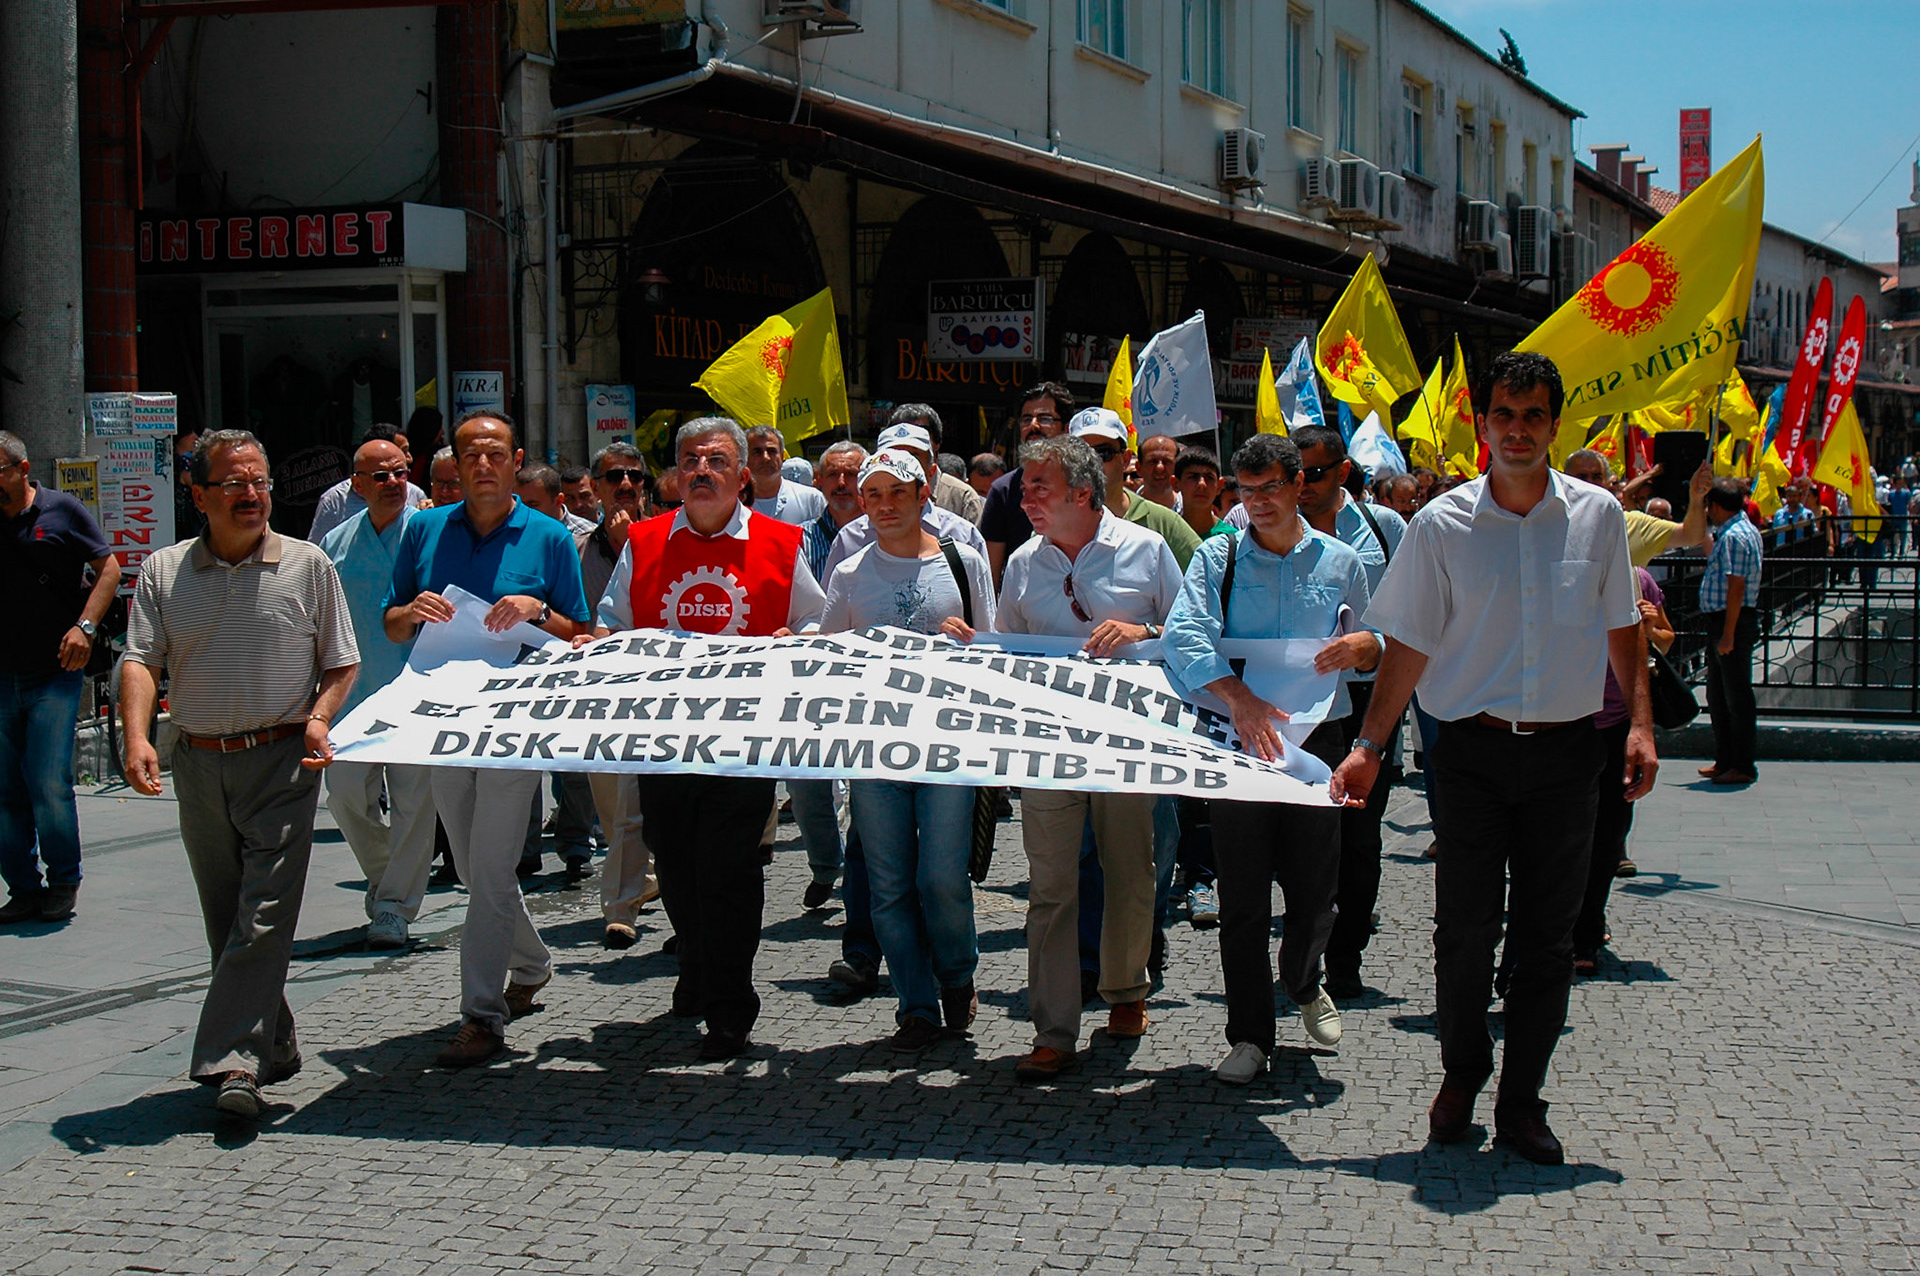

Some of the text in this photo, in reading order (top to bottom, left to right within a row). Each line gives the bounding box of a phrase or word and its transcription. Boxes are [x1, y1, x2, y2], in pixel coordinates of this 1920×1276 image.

[139, 210, 392, 263] İNTERNET
[933, 293, 1032, 311] BARUTÇU
[653, 306, 722, 360] KİTAP
[962, 315, 1018, 323] SAYISAL
[952, 325, 1020, 354] LOTO
[1023, 316, 1033, 354] 6/49
[457, 379, 499, 393] IKRA
[678, 593, 731, 617] DİSK
[790, 660, 867, 679] VE
[488, 691, 761, 722] TÜRKİYE
[779, 691, 914, 731] İÇİN
[429, 725, 1228, 790] DİSK-KESK-TMMOB-TTB-TDB
